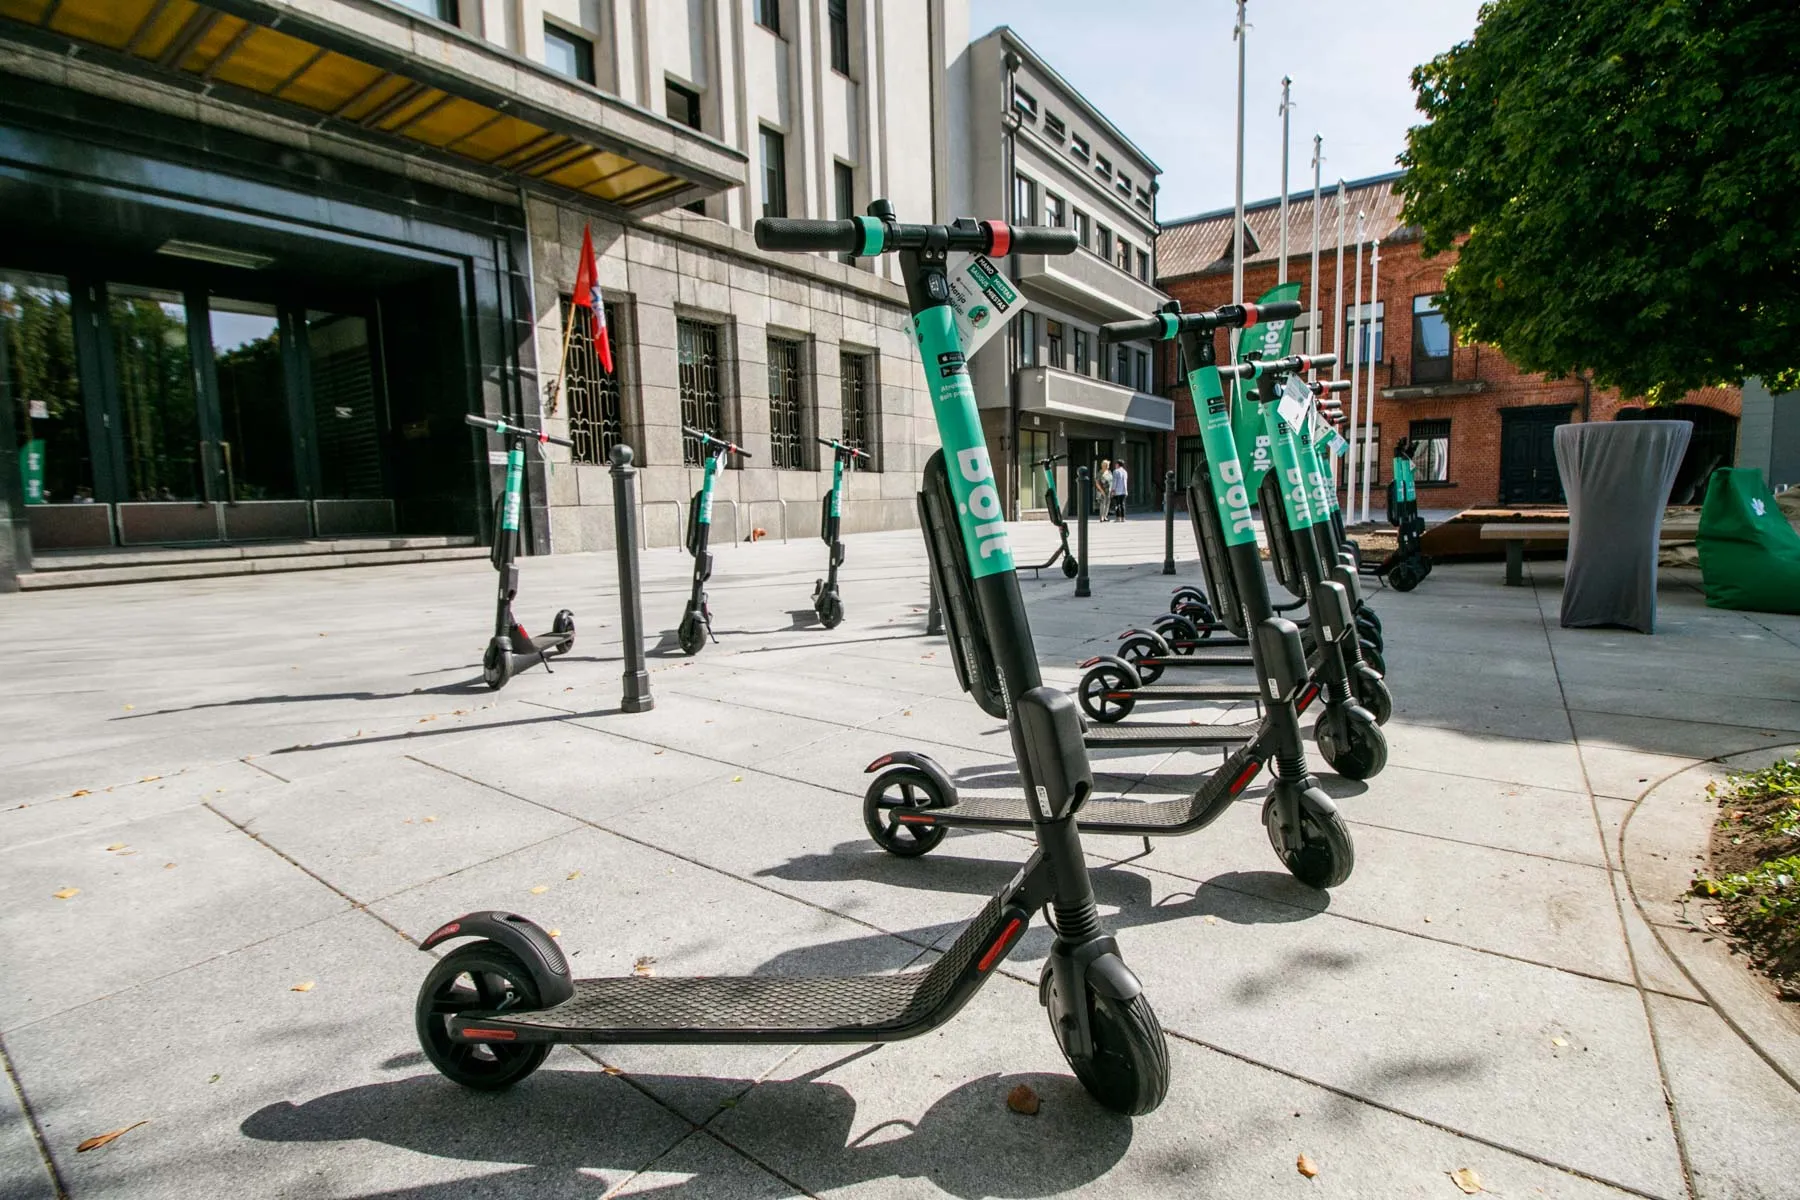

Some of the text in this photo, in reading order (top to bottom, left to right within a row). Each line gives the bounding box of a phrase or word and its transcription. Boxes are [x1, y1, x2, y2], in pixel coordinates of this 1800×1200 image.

[970, 266, 1007, 311] SAUGUS MIESTAS
[979, 258, 1013, 300] MANO MIESTAS
[1260, 319, 1286, 356] Bolt
[1250, 435, 1271, 472] Bolt
[957, 446, 1011, 560] Bolt
[1218, 459, 1255, 534] Bolt
[1285, 467, 1312, 521] Bolt
[1307, 471, 1329, 516] Bolt
